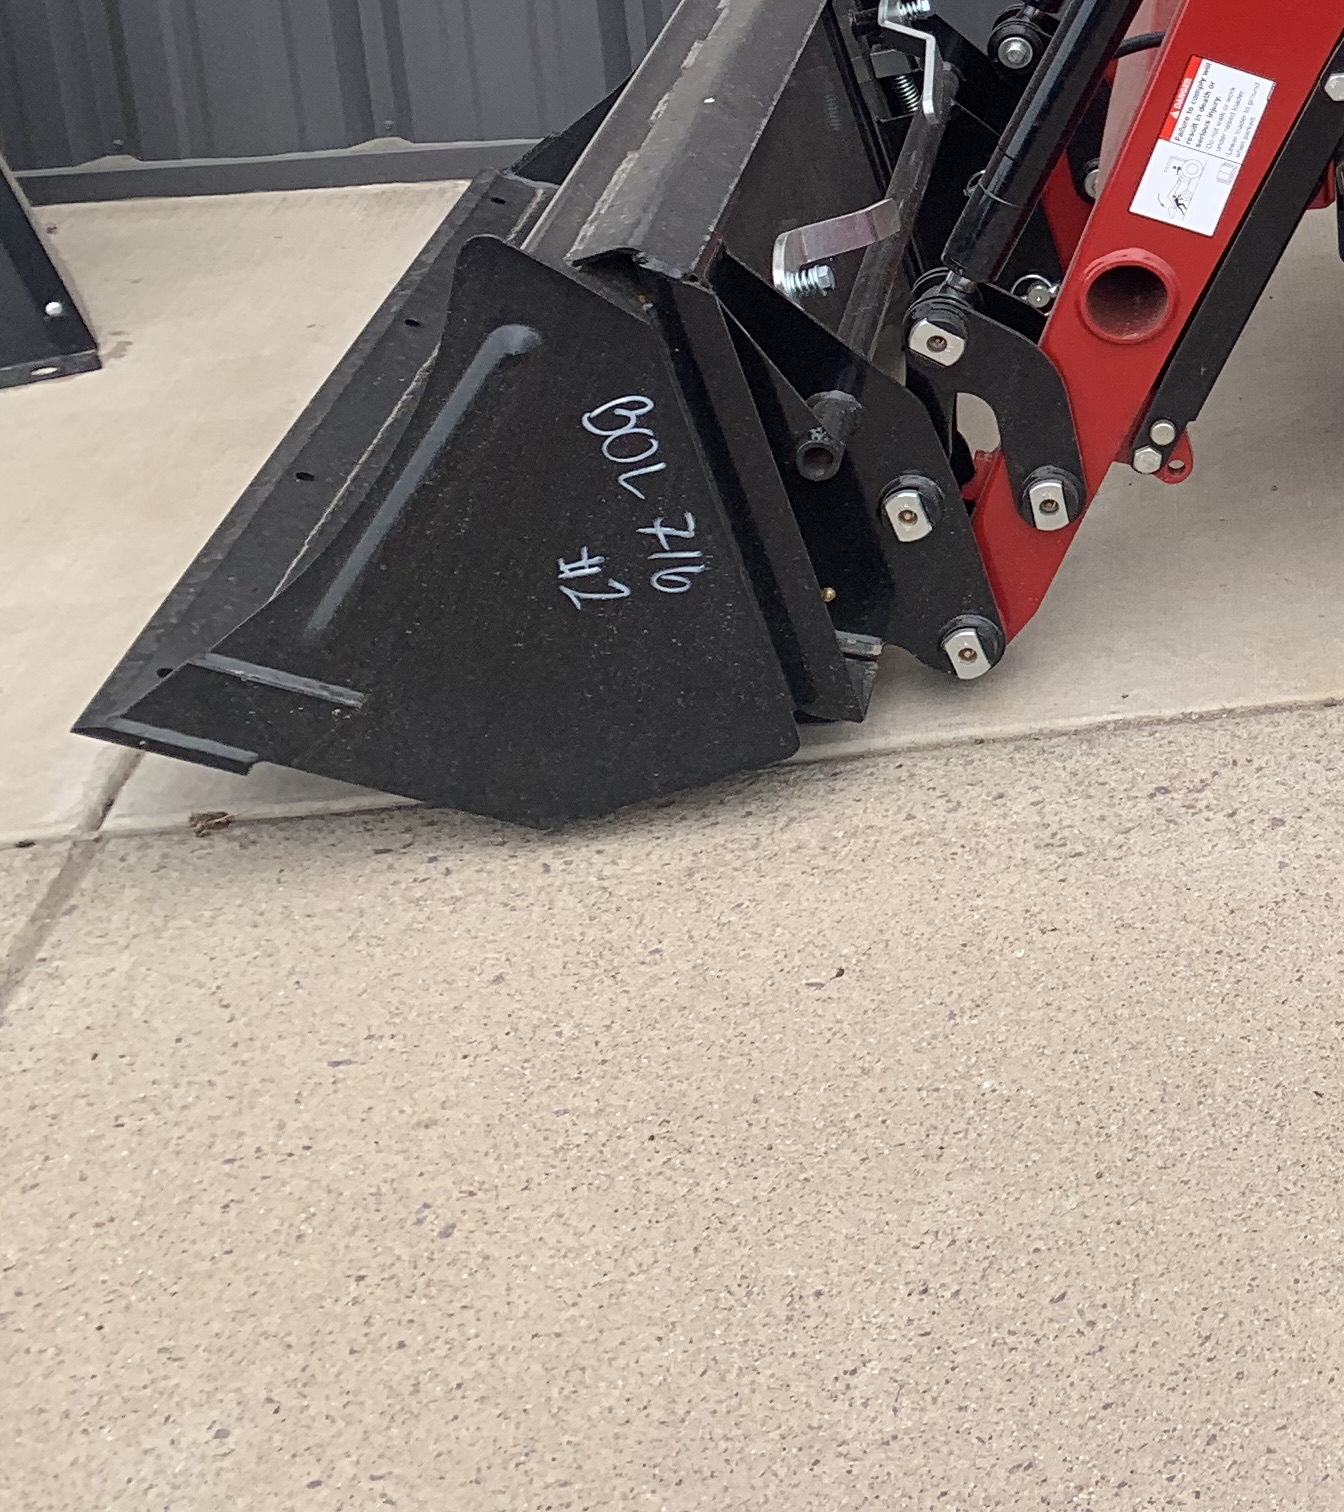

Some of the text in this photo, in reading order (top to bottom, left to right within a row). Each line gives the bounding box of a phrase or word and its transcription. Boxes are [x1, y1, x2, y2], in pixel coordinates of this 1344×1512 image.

[1173, 76, 1191, 109] DANGER
[1189, 76, 1206, 105] comply
[1184, 122, 1198, 144] result
[1197, 90, 1211, 112] death
[1185, 106, 1194, 114] to
[1174, 115, 1190, 141] Failure
[1194, 119, 1210, 147] serious
